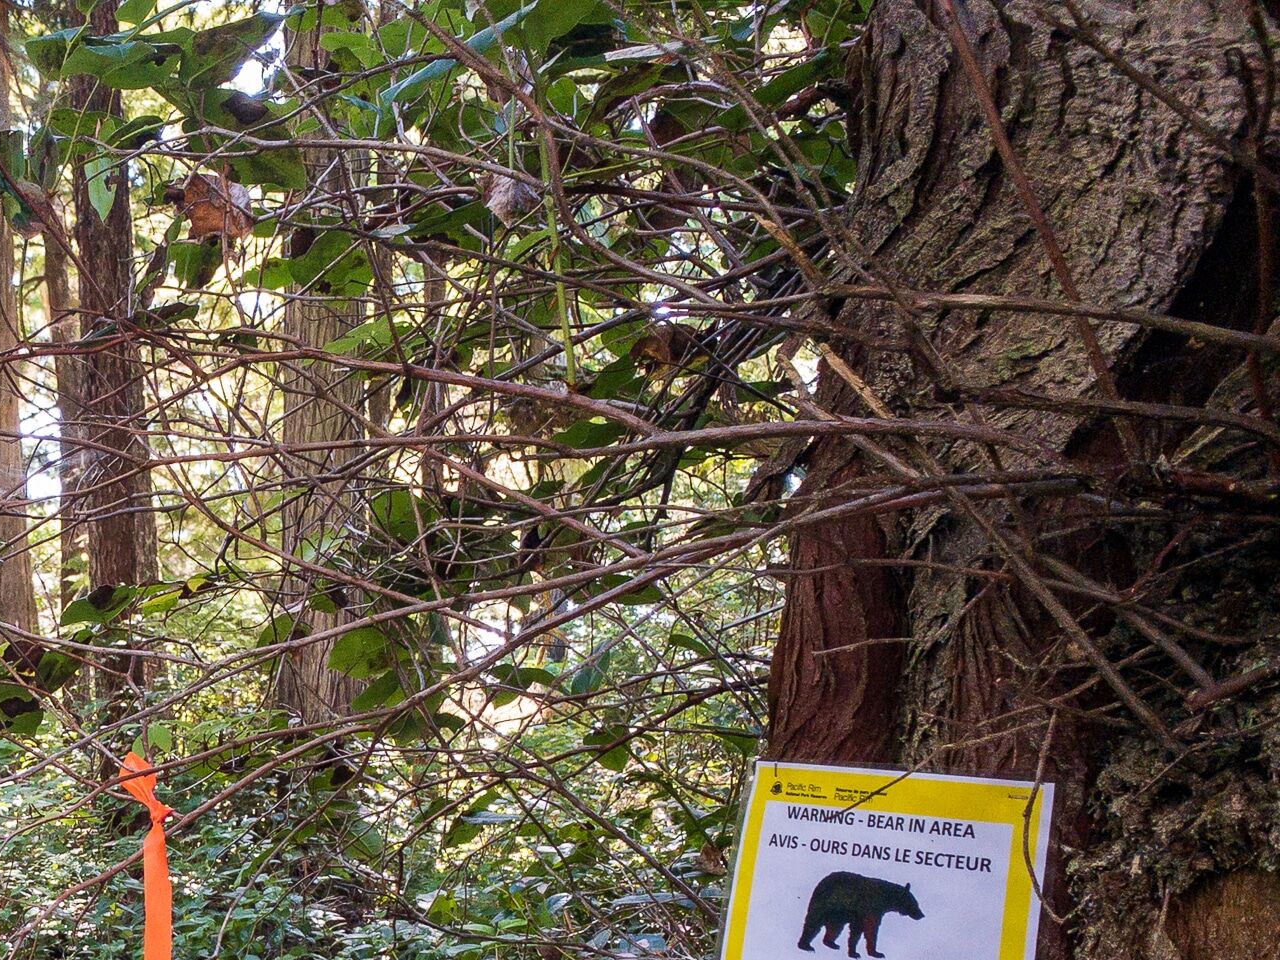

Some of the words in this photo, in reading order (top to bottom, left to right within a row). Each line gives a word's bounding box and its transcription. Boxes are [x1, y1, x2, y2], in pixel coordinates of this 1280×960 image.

[788, 806, 855, 825] WARNING
[867, 814, 904, 831] BEAR
[908, 818, 925, 833] IN
[929, 821, 975, 838] AREA
[769, 833, 798, 848] AVIS
[810, 838, 848, 855] OURS
[851, 843, 890, 860] DANS
[895, 848, 911, 863] LE
[914, 851, 991, 872] SECTEUR
